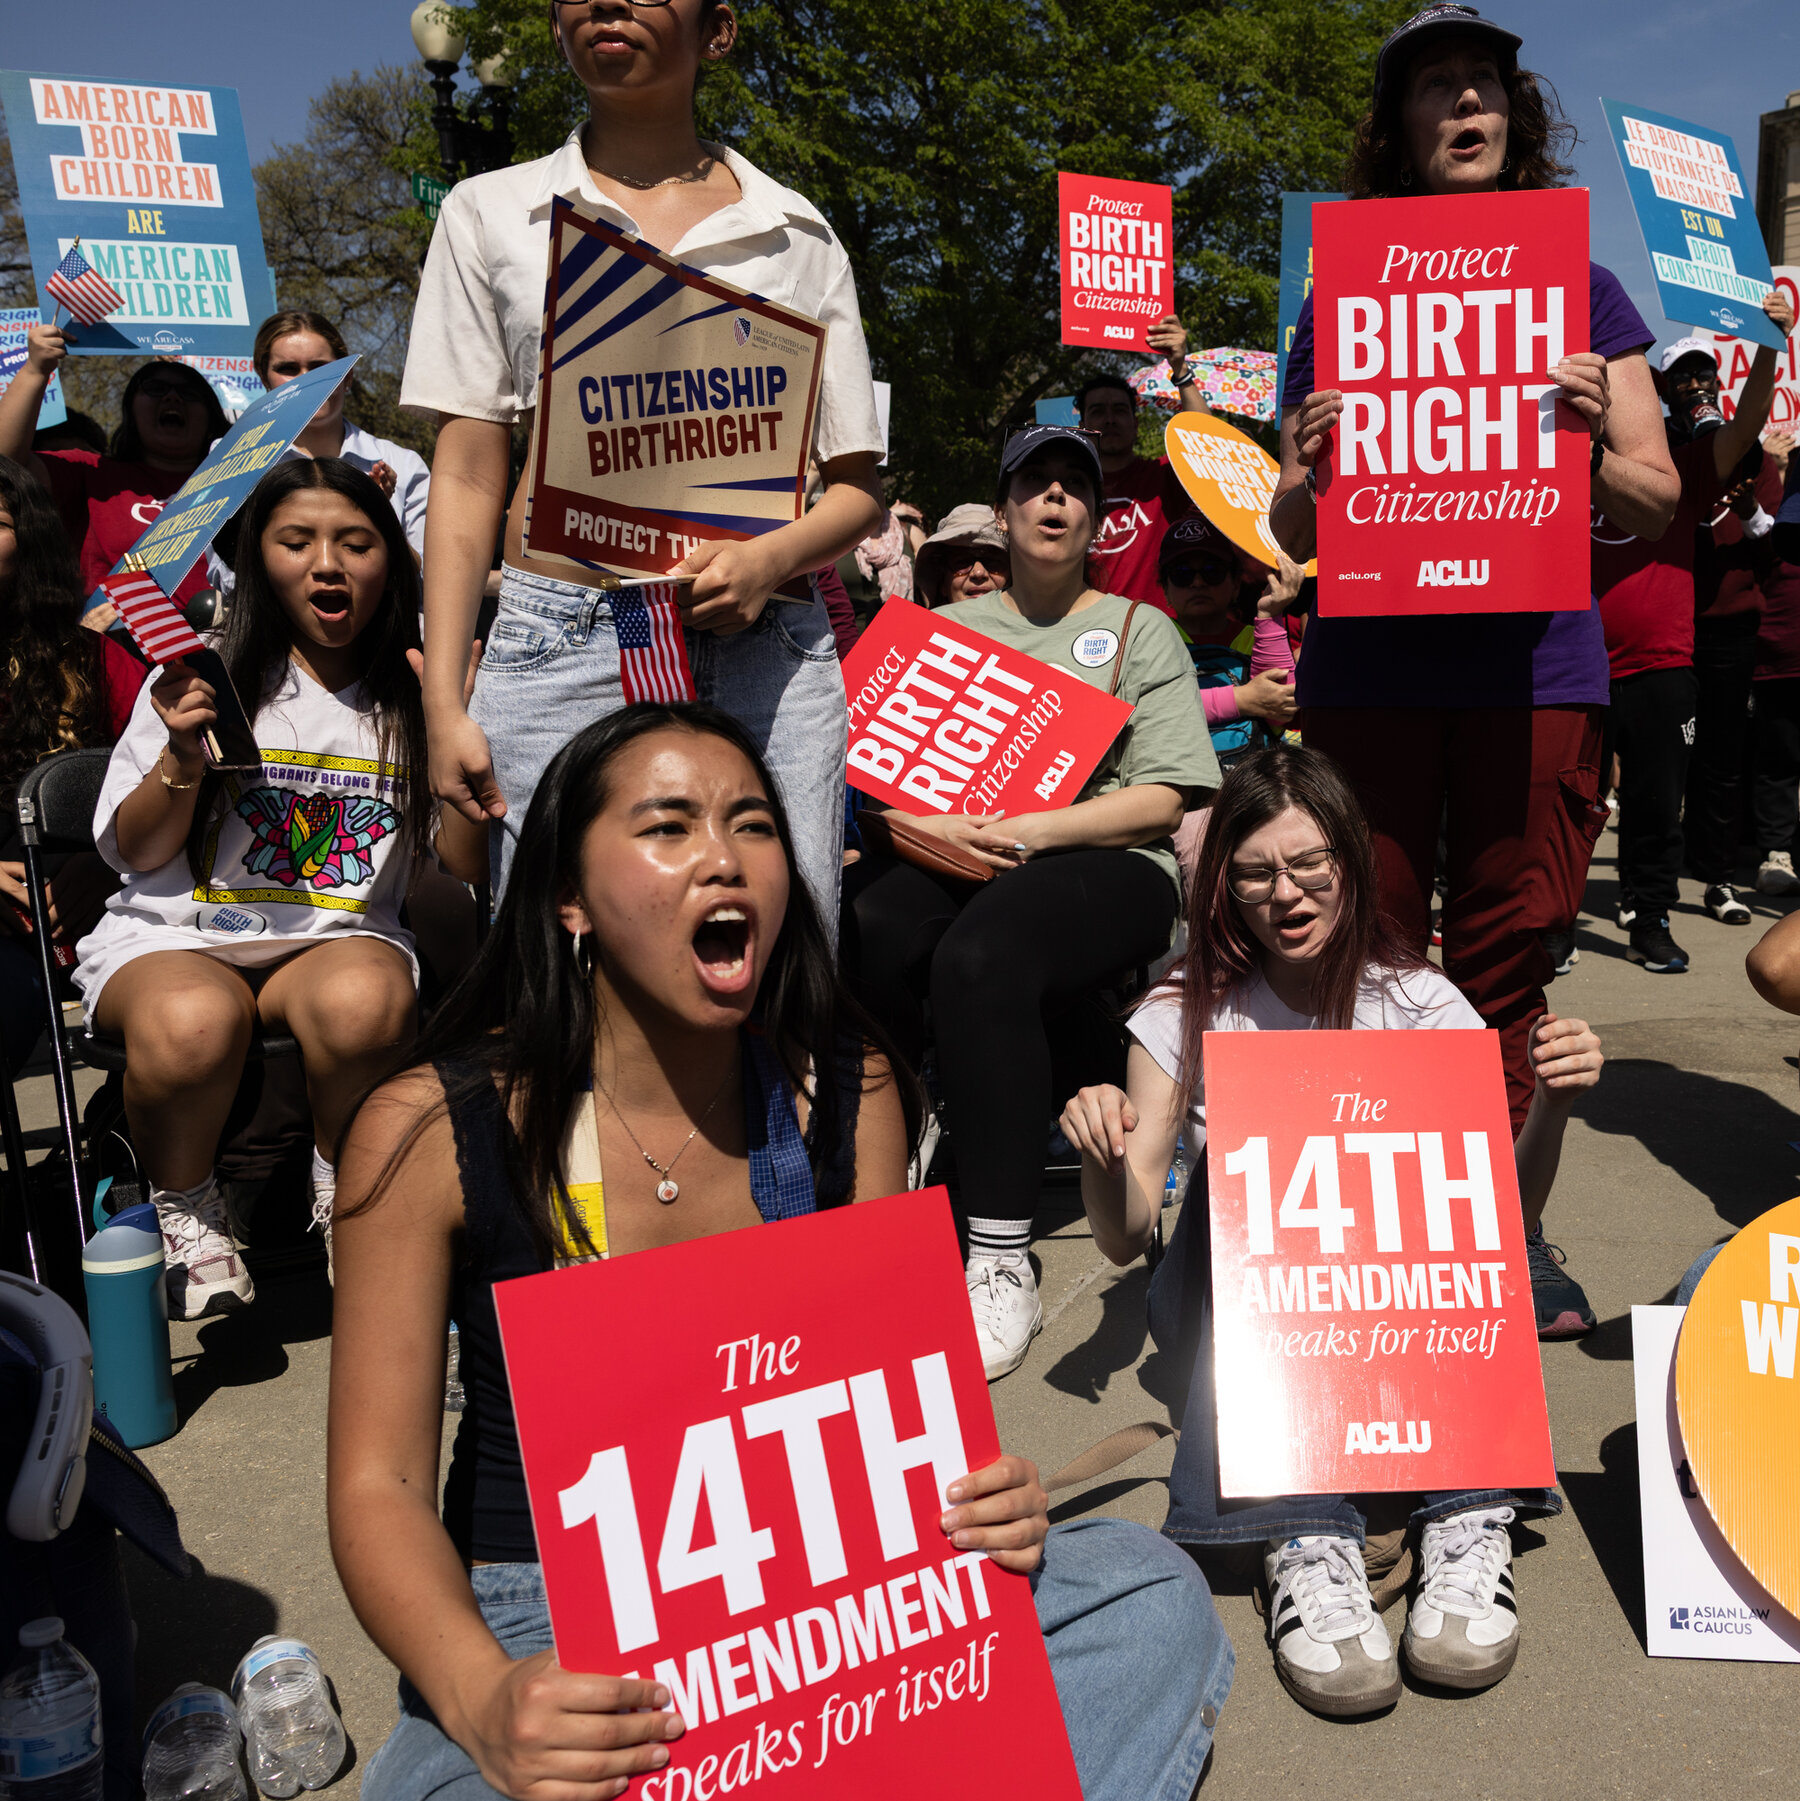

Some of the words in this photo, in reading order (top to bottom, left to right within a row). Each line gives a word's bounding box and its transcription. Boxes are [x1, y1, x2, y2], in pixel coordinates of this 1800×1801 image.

[42, 83, 208, 129] AMERICAN
[88, 124, 174, 163] BORN
[1627, 120, 1643, 142] LE
[1647, 125, 1692, 156] DROIT
[1707, 142, 1726, 167] LA
[59, 159, 215, 202] CHILDREN
[1628, 144, 1719, 188] CITOYENNETÉ
[1721, 171, 1740, 195] DE
[1086, 194, 1144, 217] Protect
[1654, 175, 1732, 214] NAISSANCE
[127, 209, 166, 235] ARE
[1069, 211, 1163, 258] BIRTH
[1680, 209, 1703, 232] EST
[1704, 216, 1725, 239] UN
[1070, 250, 1166, 296] RIGHT
[1378, 243, 1520, 283] Protect
[1690, 239, 1731, 269] DROIT
[1073, 291, 1163, 318] Citizenship
[137, 336, 150, 344] WE
[753, 326, 774, 339] LEAGUE
[779, 337, 798, 349] UNITED
[796, 344, 811, 353] LATIN
[1103, 325, 1135, 340] ACLU
[1337, 286, 1565, 381] BIRTH
[578, 365, 788, 425] CITIZENSHIP
[587, 411, 783, 477] BIRTHRIGHT
[1174, 427, 1270, 471] RESPECT
[1339, 383, 1565, 476] RIGHT
[1181, 451, 1267, 491] WOMEN
[1217, 481, 1276, 513] COLO
[1346, 478, 1561, 527] Citizenship
[564, 507, 661, 556] PROTECT
[666, 531, 712, 560] TH
[1174, 525, 1211, 539] CASA
[1338, 571, 1381, 582] aclu.org
[1416, 559, 1490, 587] ACLU
[1083, 646, 1108, 656] RIGHT
[1084, 639, 1108, 648] BIRTH
[846, 631, 983, 786] BIRTH
[847, 644, 907, 734] Protect
[898, 653, 1036, 813] RIGHT
[962, 688, 1064, 816] Citizenship
[321, 772, 370, 789] BELONG
[1034, 749, 1076, 801] ACLU
[210, 913, 246, 935] RIGHT
[218, 907, 253, 929] BIRTH
[1331, 1092, 1388, 1122] The
[1225, 1131, 1501, 1256] 14TH
[1239, 1262, 1507, 1313] AMENDMENT
[1262, 1323, 1361, 1362] peaks
[1363, 1321, 1419, 1362] for
[1425, 1319, 1507, 1360] itself
[715, 1333, 802, 1393] The
[1344, 1420, 1432, 1455] ACLU
[557, 1350, 971, 1655] 14TH
[1693, 1606, 1737, 1620] ASIAN
[1740, 1608, 1770, 1621] LAW
[1694, 1621, 1753, 1635] CAUCUS
[639, 1720, 805, 1801] speaks
[813, 1688, 886, 1769] for
[897, 1631, 1000, 1722] itself
